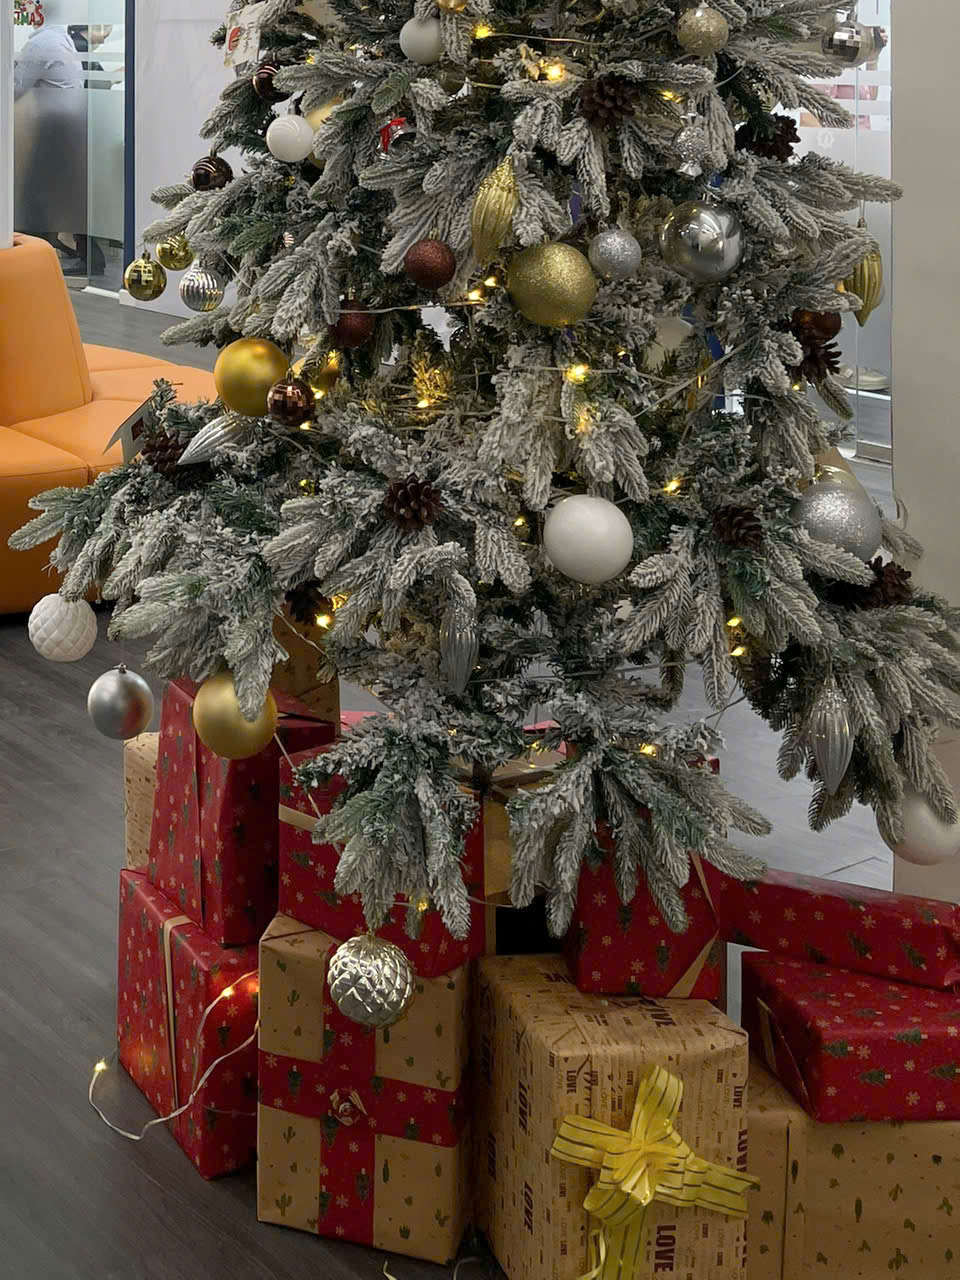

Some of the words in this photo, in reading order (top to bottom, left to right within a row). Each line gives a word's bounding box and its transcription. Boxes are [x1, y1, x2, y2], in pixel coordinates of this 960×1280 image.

[567, 1070, 577, 1095] LOVE
[733, 1085, 745, 1110] LOVE
[654, 1224, 676, 1273] LOVE
